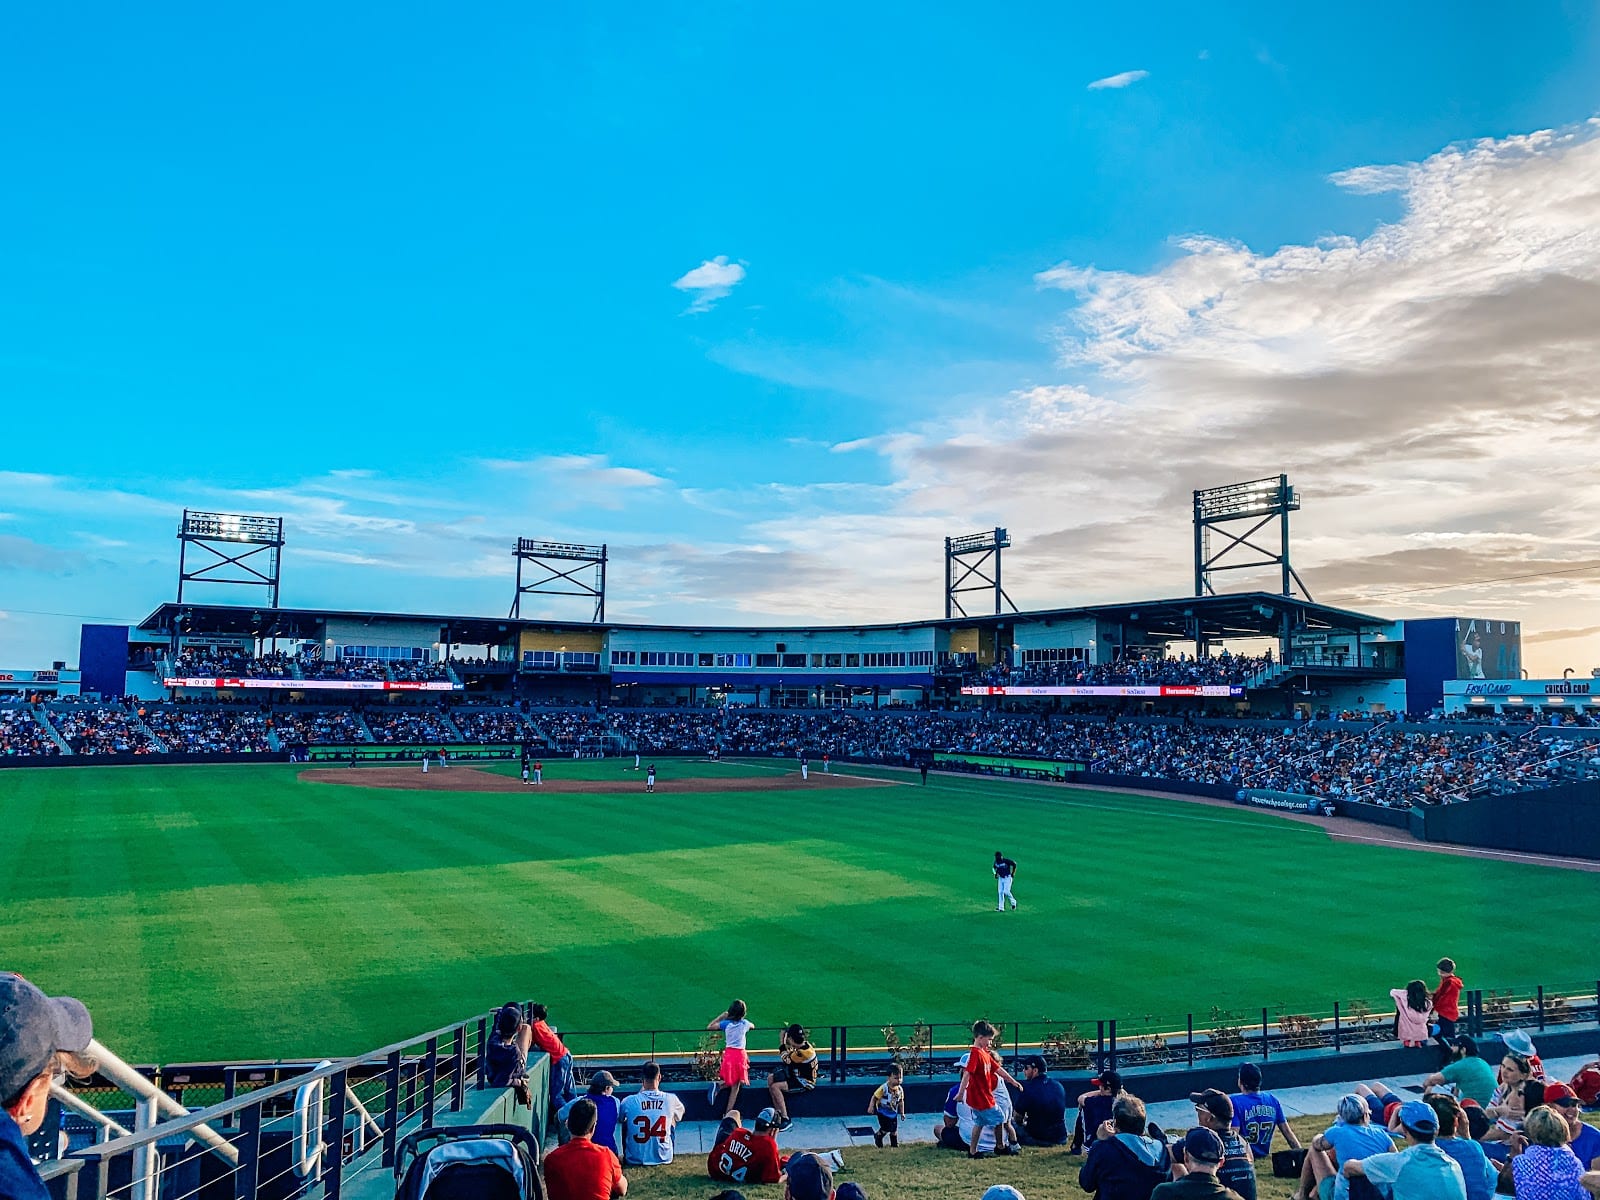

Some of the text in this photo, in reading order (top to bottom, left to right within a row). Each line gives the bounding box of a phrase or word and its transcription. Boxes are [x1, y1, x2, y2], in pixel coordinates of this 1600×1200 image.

[1455, 619, 1520, 636] AARON
[1497, 643, 1519, 679] 44
[1487, 682, 1512, 694] CAMP
[641, 1100, 664, 1111] ORTIZ
[633, 1115, 667, 1144] 34
[1244, 1121, 1274, 1145] 37
[729, 1139, 753, 1162] ORTIZ
